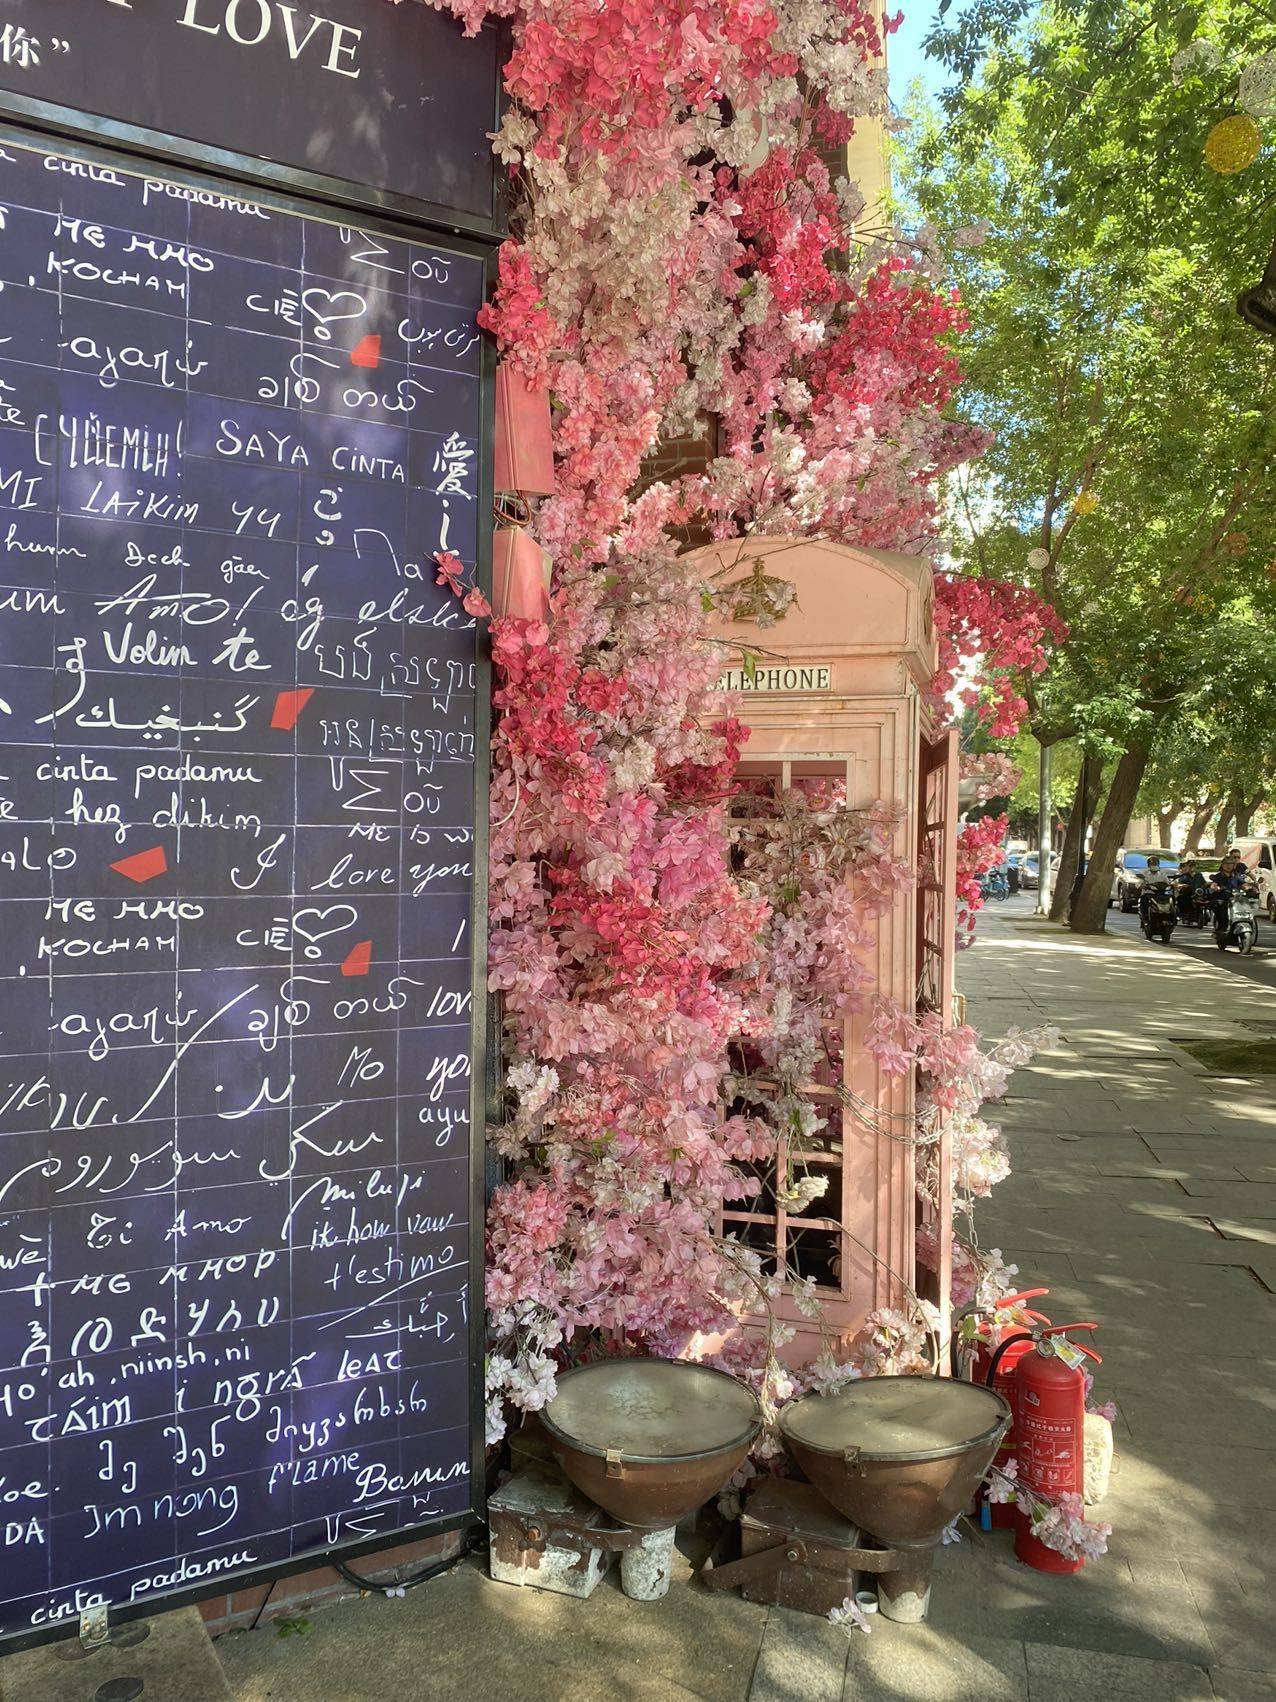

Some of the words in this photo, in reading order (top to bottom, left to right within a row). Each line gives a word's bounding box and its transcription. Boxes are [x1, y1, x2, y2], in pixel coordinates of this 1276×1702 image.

[177, 0, 363, 78] LOVE
[216, 419, 310, 466] SAYA
[433, 430, 474, 500] 愛
[103, 622, 198, 667] Volim
[712, 668, 829, 691] LEPHONE
[36, 754, 118, 783] cinta
[135, 755, 263, 799] padamu
[31, 1588, 111, 1625] cinta
[131, 1549, 258, 1602] padamu
